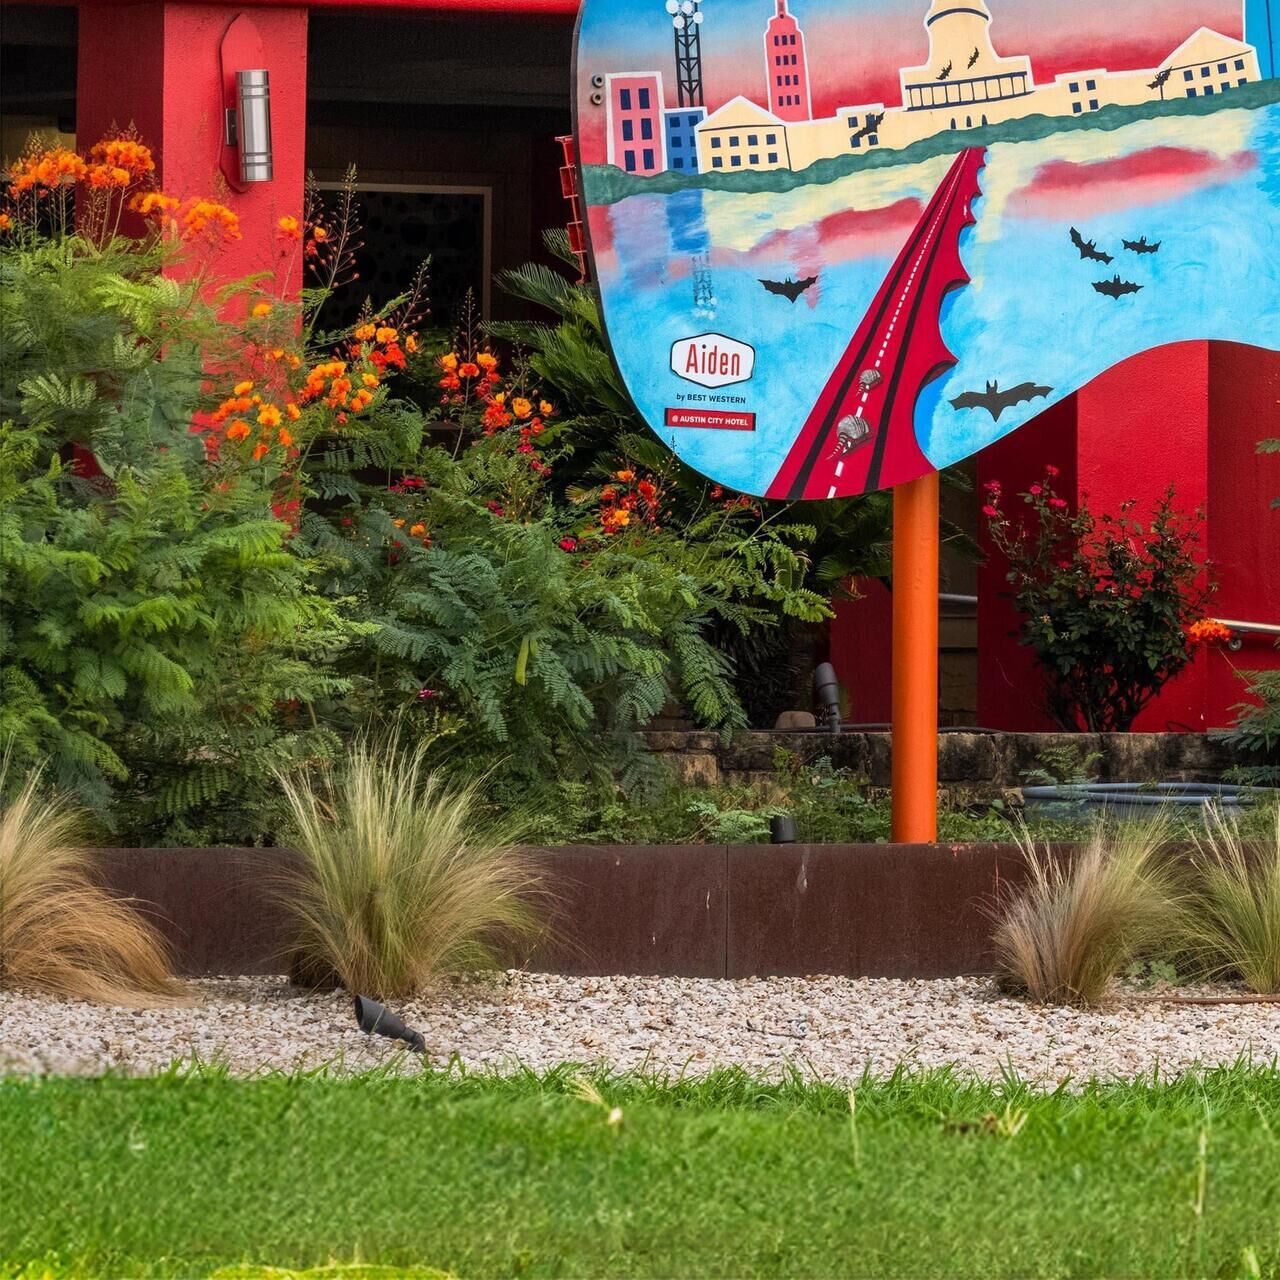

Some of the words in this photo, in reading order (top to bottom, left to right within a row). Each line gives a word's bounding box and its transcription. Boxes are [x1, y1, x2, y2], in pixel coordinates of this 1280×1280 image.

[686, 344, 740, 376] Aiden
[676, 393, 685, 402] by
[687, 394, 707, 402] BEST
[708, 395, 746, 404] WESTERN
[680, 415, 706, 424] AUSTIN
[707, 416, 724, 425] CITY
[725, 418, 749, 426] HOTEL
